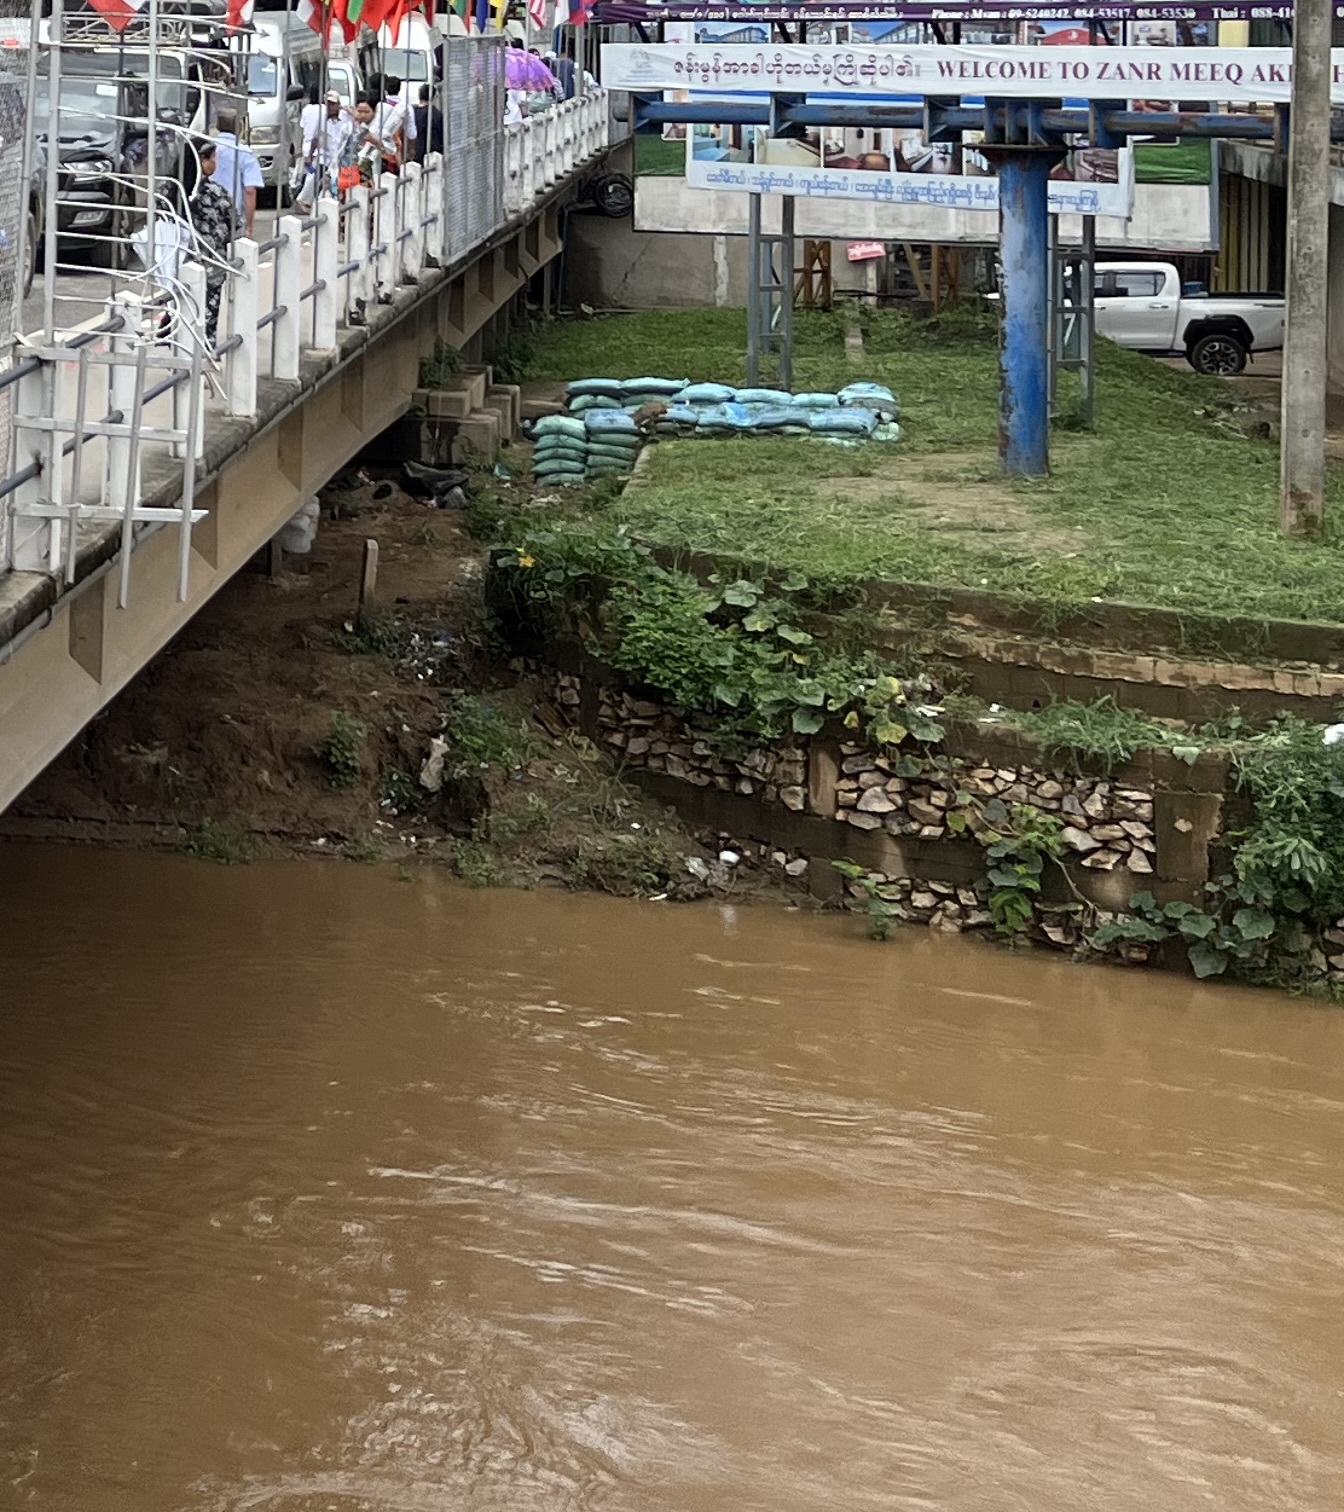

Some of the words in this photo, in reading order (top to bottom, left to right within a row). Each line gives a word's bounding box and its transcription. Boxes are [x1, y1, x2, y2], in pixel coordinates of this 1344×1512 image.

[937, 59, 1052, 80] WELCOME
[1060, 61, 1090, 80] TO
[1096, 61, 1163, 82] ZANR
[1169, 62, 1244, 85] MEEQ
[1250, 64, 1294, 82] AK
